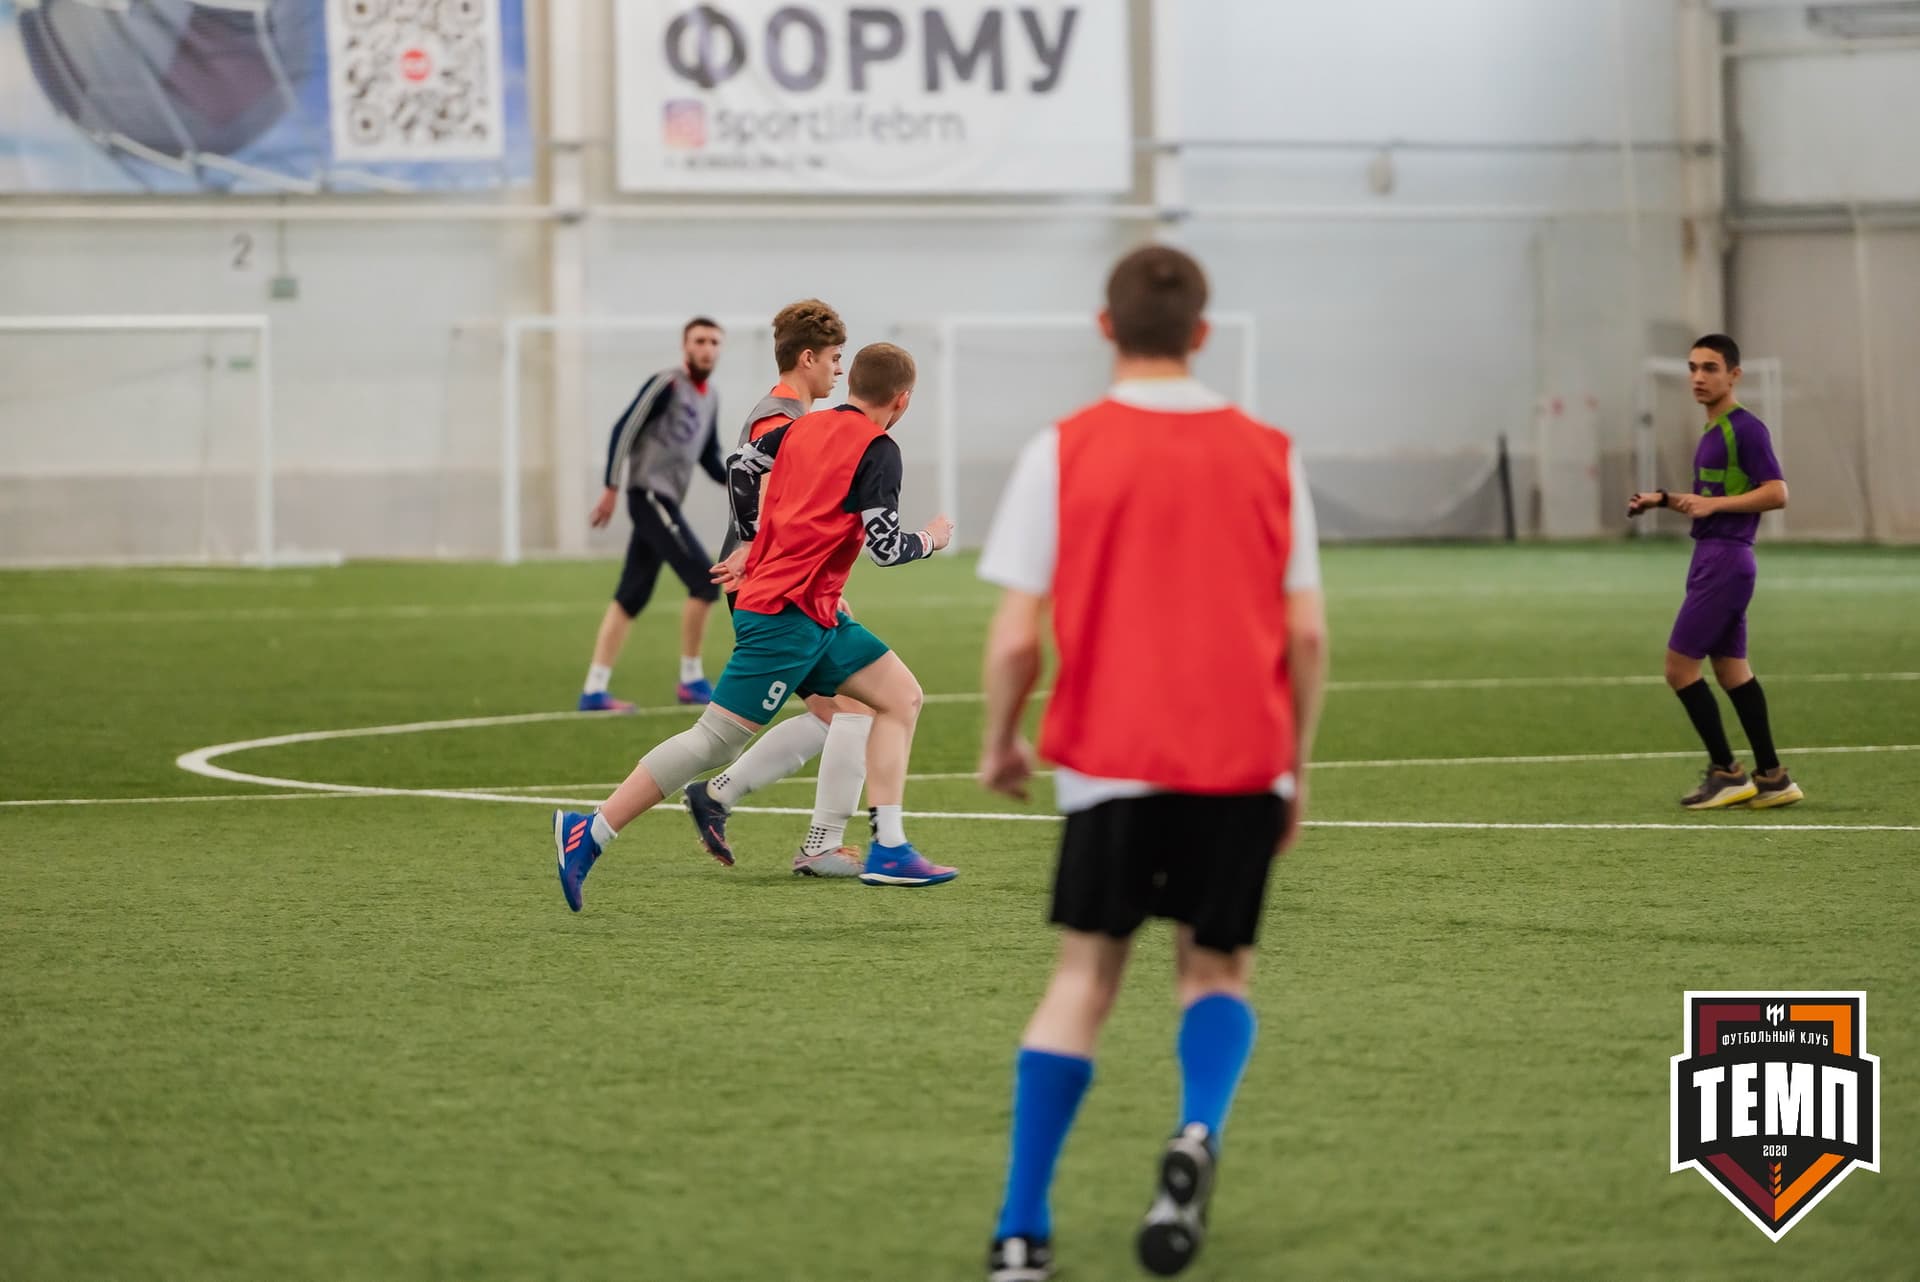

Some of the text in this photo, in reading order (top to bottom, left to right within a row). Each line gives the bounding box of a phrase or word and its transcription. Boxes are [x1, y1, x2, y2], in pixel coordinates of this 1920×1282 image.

[664, 2, 1079, 93] ФОРМУ
[230, 233, 254, 271] 2
[762, 680, 787, 711] 9
